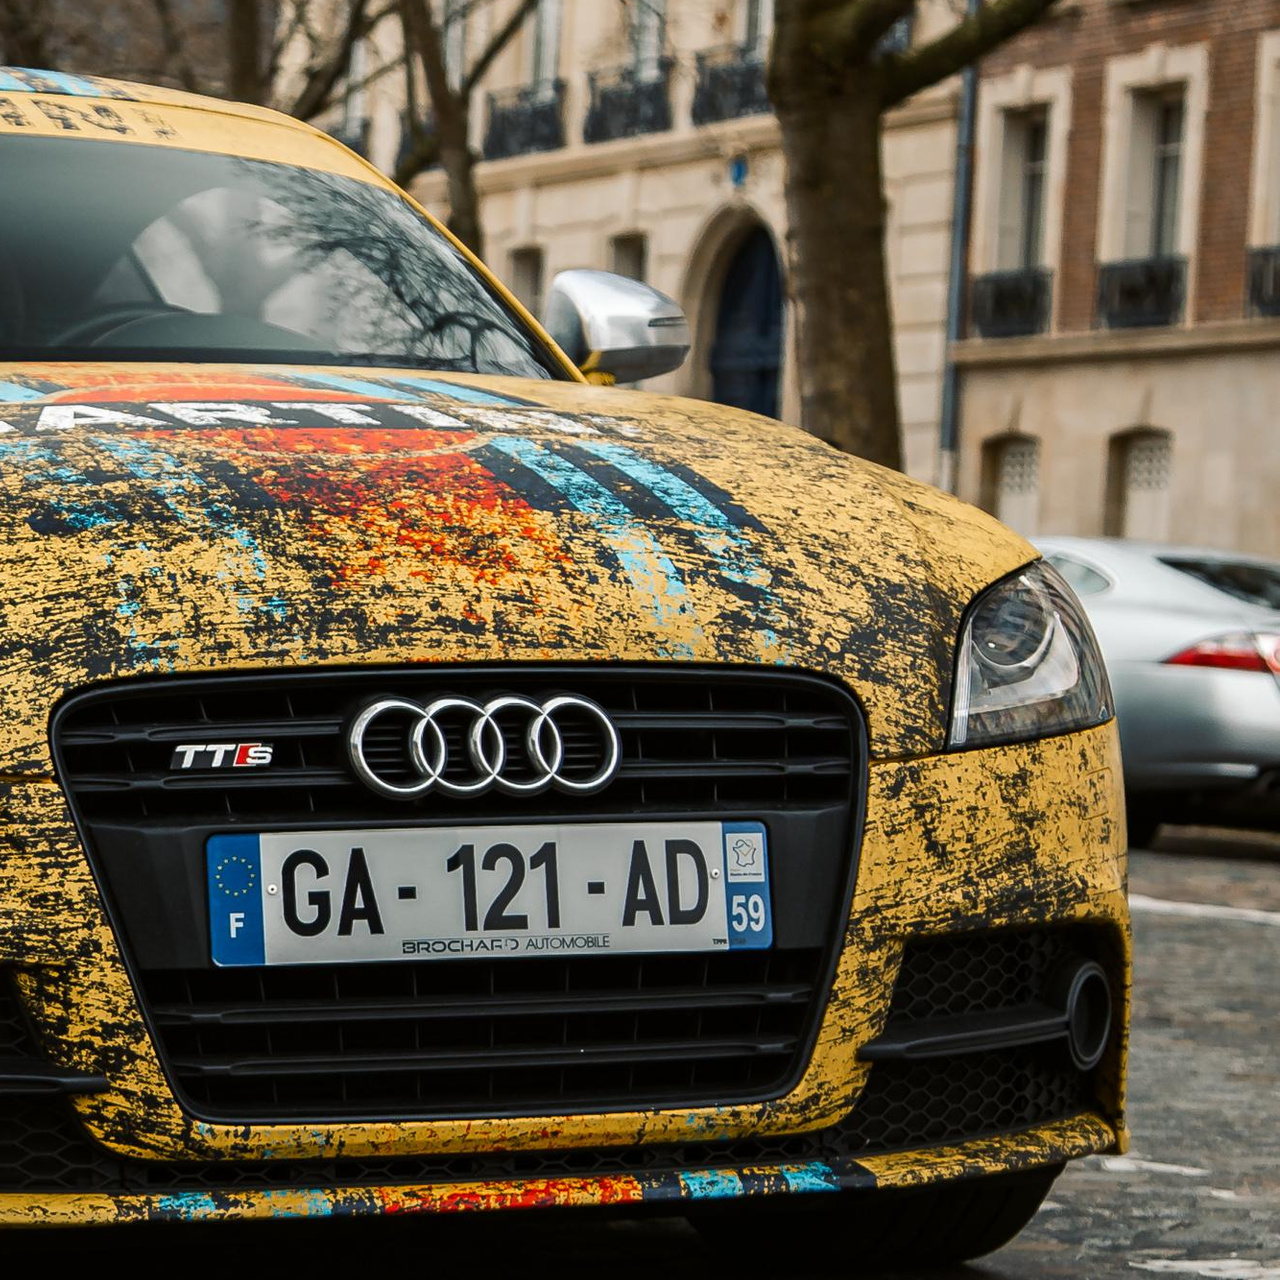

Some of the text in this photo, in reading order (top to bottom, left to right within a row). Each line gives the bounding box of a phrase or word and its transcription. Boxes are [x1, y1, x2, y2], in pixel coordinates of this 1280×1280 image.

[175, 743, 273, 769] TTS
[229, 913, 245, 938] F
[732, 894, 766, 932] 59
[525, 934, 610, 950] AUTOMOBILE
